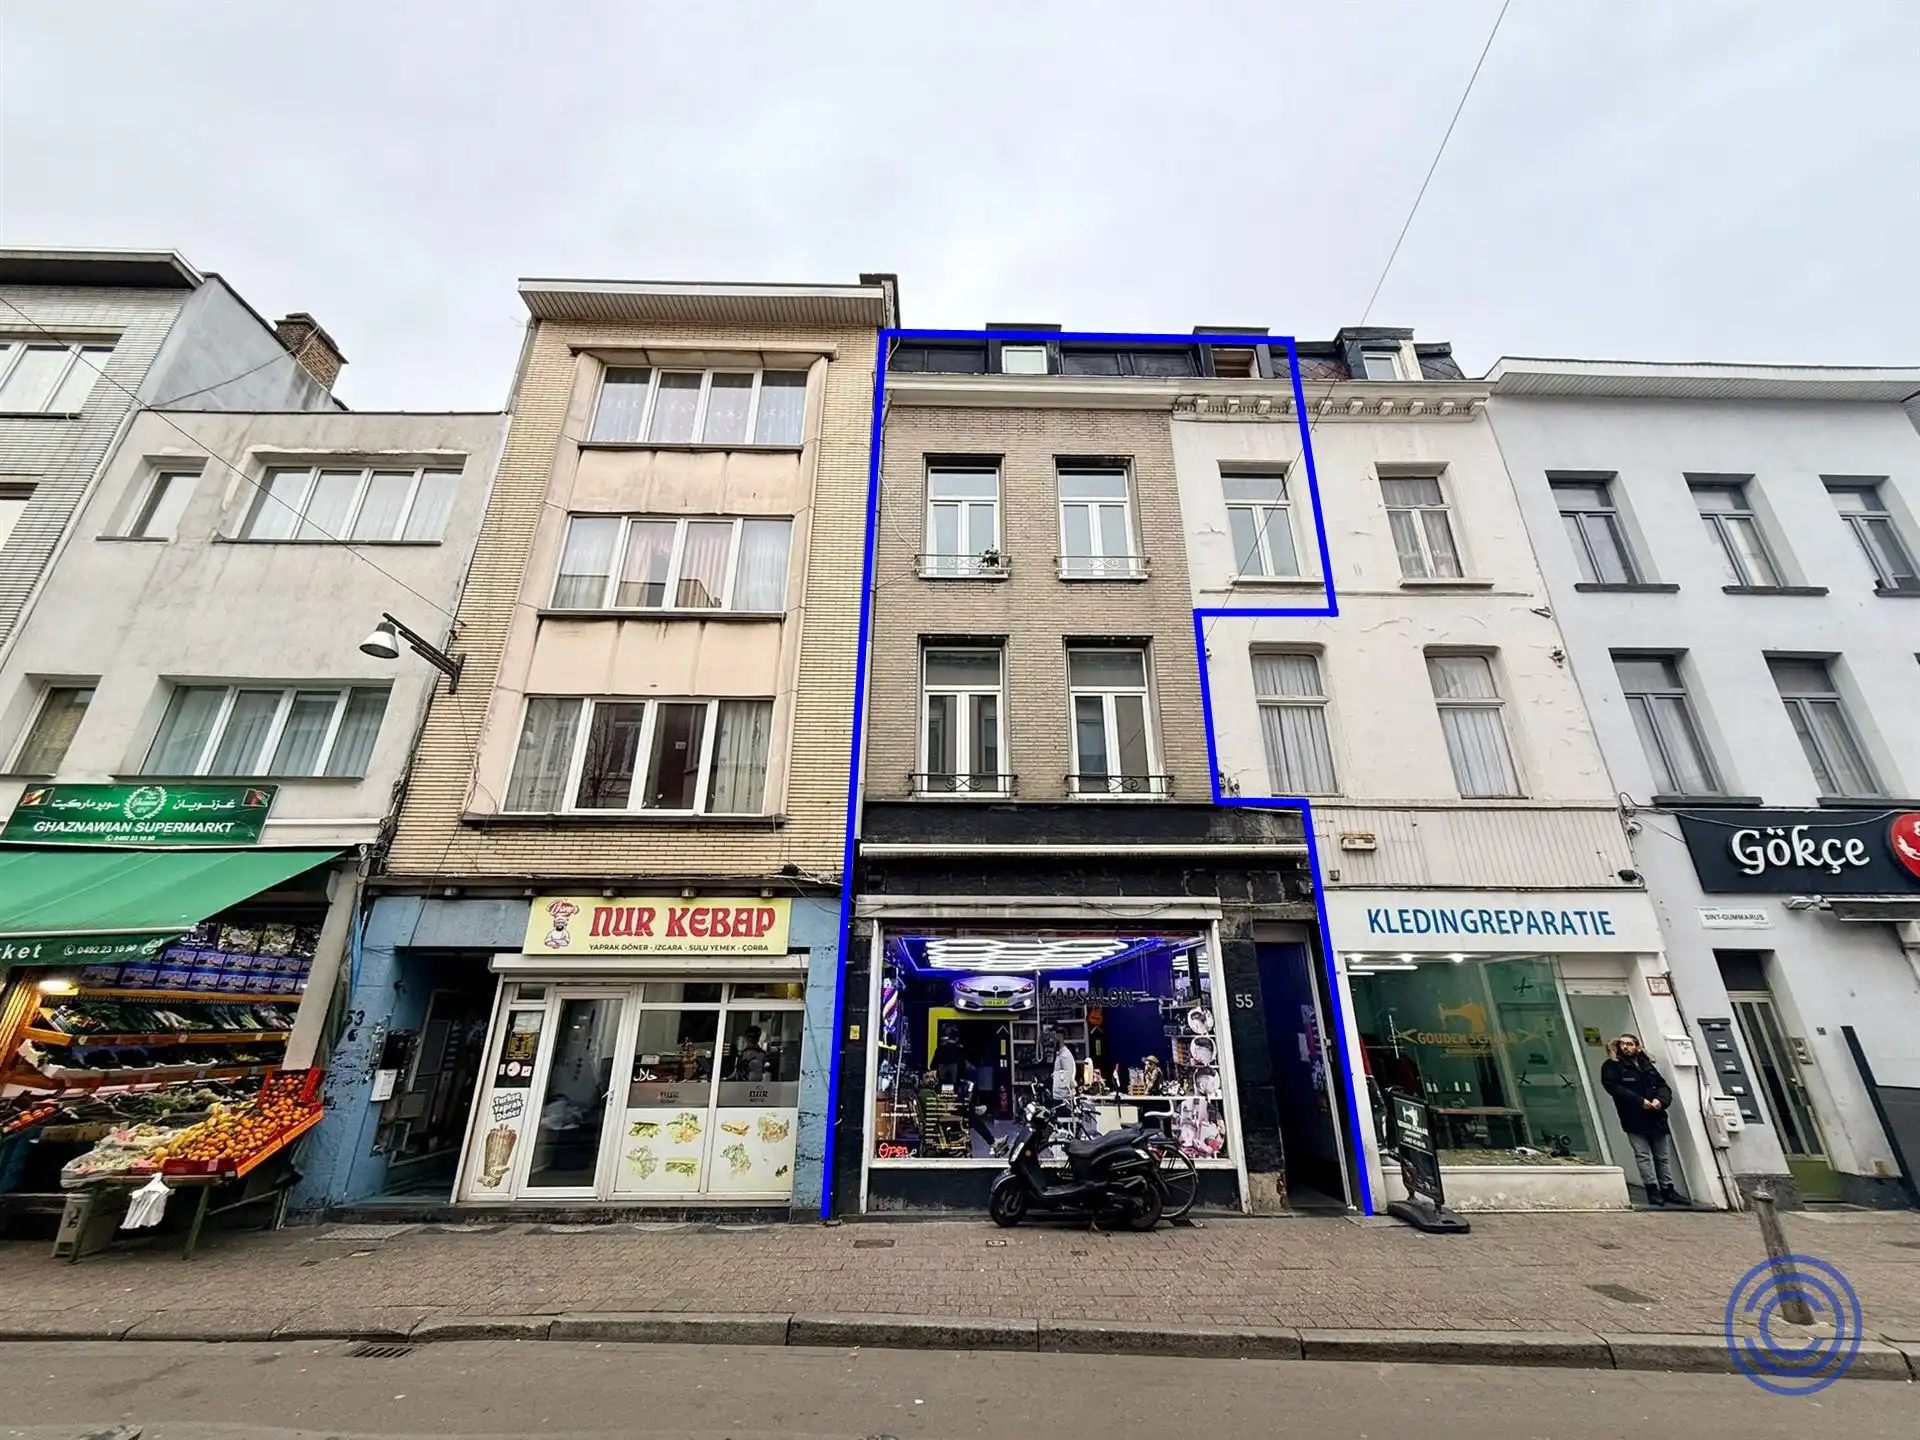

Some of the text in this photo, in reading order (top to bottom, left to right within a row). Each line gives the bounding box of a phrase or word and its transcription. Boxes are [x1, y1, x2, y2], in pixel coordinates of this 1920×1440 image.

[33, 821, 235, 833] GHAZNAWIAN SUPERMARKT
[1731, 825, 1871, 875] Gökçe
[588, 907, 776, 938] NUR KEBAP
[1367, 908, 1616, 936] KLEDINGREPARATIE
[0, 943, 42, 960] ket
[589, 943, 620, 951] YAPRAK
[621, 942, 649, 951] DÖNER
[742, 944, 769, 953] ÇORBA
[1041, 987, 1134, 1009] KAPSALON
[1235, 994, 1254, 1009] 55
[343, 1009, 366, 1027] 53
[633, 1067, 659, 1082] حلال
[879, 1142, 909, 1160] Open
